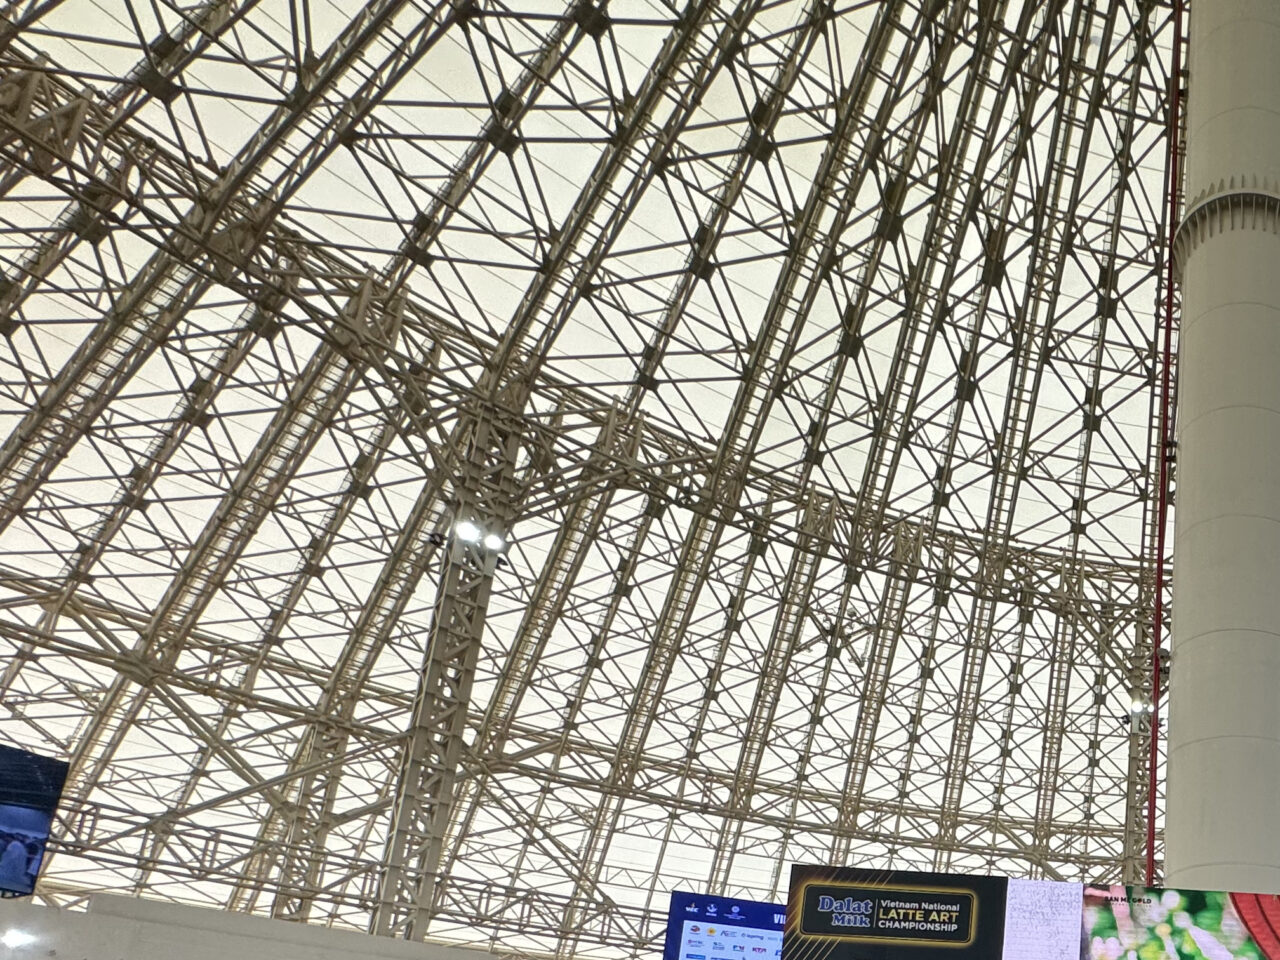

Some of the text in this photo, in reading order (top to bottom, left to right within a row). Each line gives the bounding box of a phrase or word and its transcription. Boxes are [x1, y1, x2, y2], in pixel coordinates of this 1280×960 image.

[818, 895, 873, 914] Dalat
[881, 900, 960, 912] Vietnam National
[832, 913, 871, 927] Milk
[880, 908, 960, 923] LATTE ART
[878, 920, 958, 932] CHAMPIONSHIP
